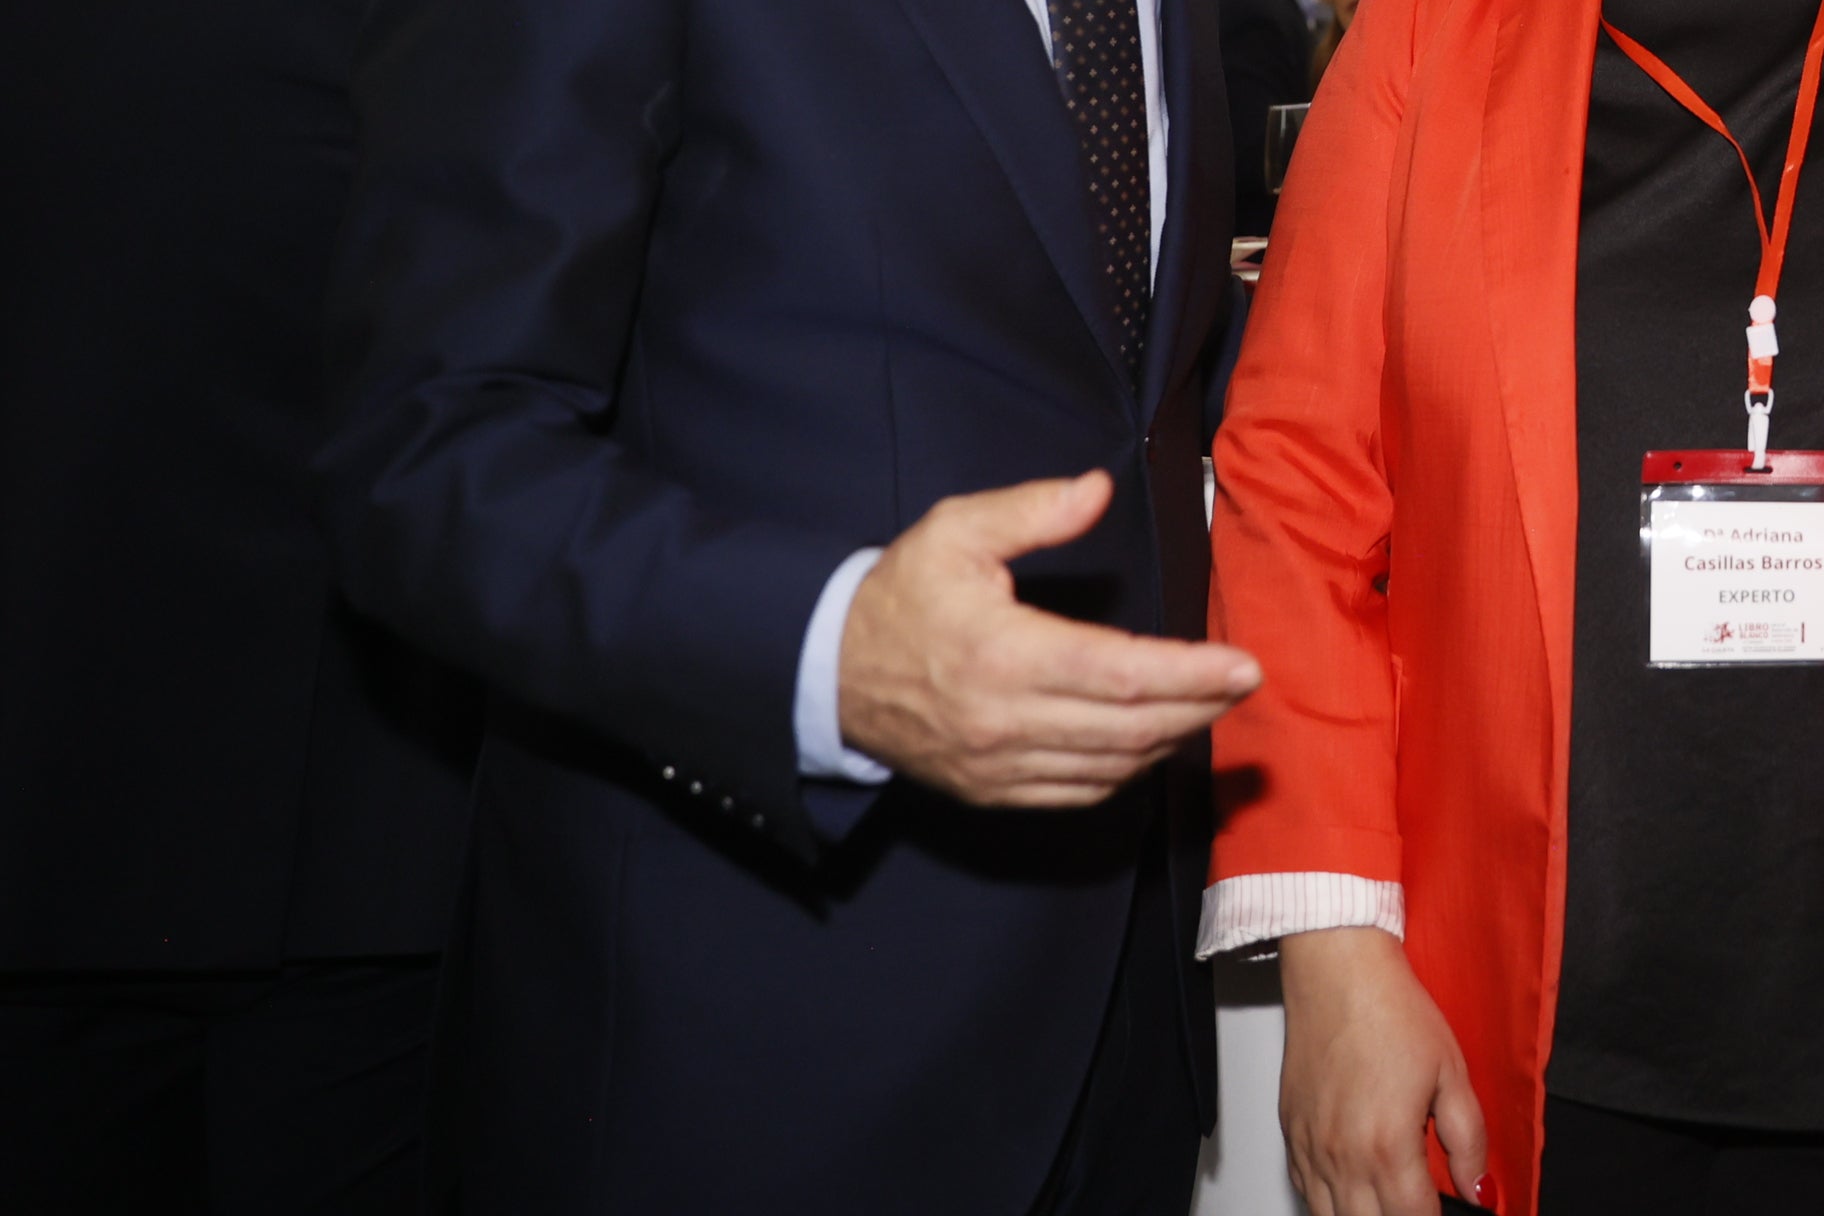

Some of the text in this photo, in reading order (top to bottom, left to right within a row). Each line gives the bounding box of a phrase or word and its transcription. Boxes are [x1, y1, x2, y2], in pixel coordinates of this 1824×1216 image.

[1731, 527, 1804, 543] Adriana
[1684, 555, 1823, 571] Casillas Barros
[1718, 588, 1796, 605] EXPERTO
